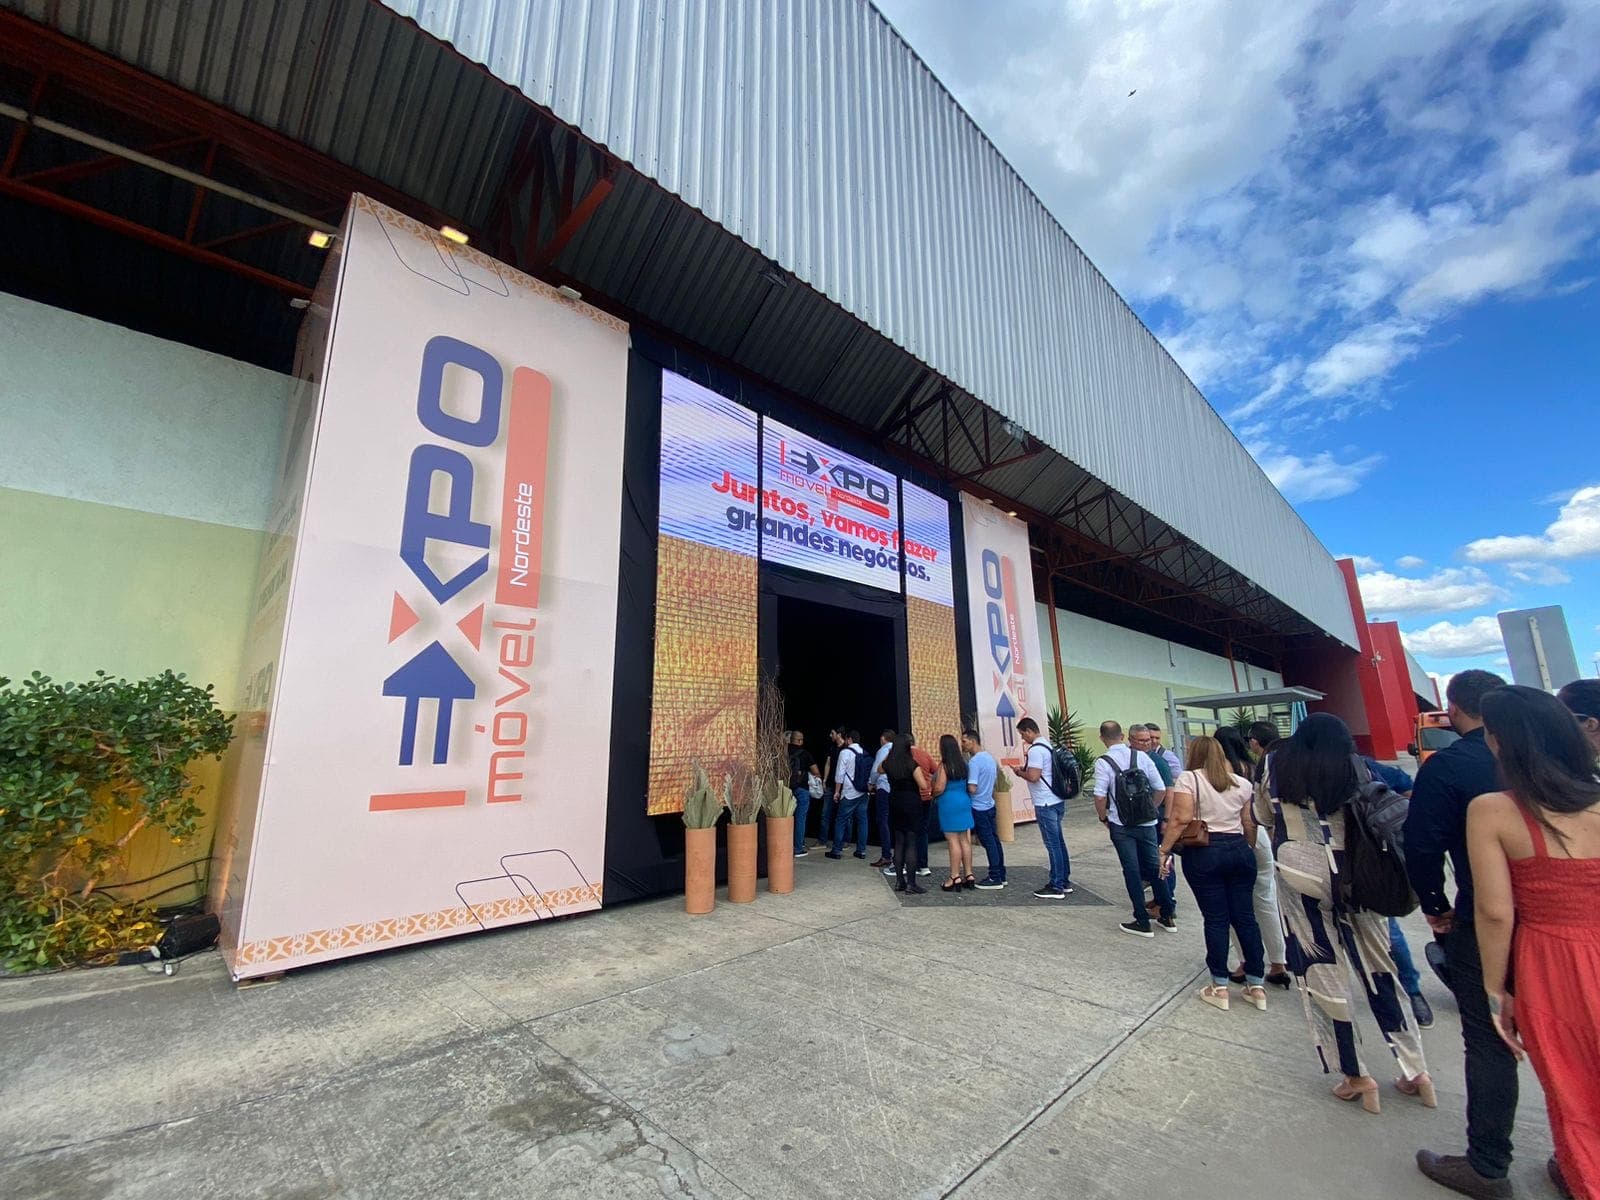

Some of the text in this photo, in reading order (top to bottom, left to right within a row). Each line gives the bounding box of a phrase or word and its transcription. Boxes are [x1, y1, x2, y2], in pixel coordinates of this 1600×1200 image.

[510, 482, 534, 587] Nordeste
[711, 471, 815, 527] Juntos,
[821, 510, 889, 547] vamos
[726, 506, 835, 552] grandes
[1009, 614, 1021, 665] Nordeste
[475, 618, 536, 804] móvel
